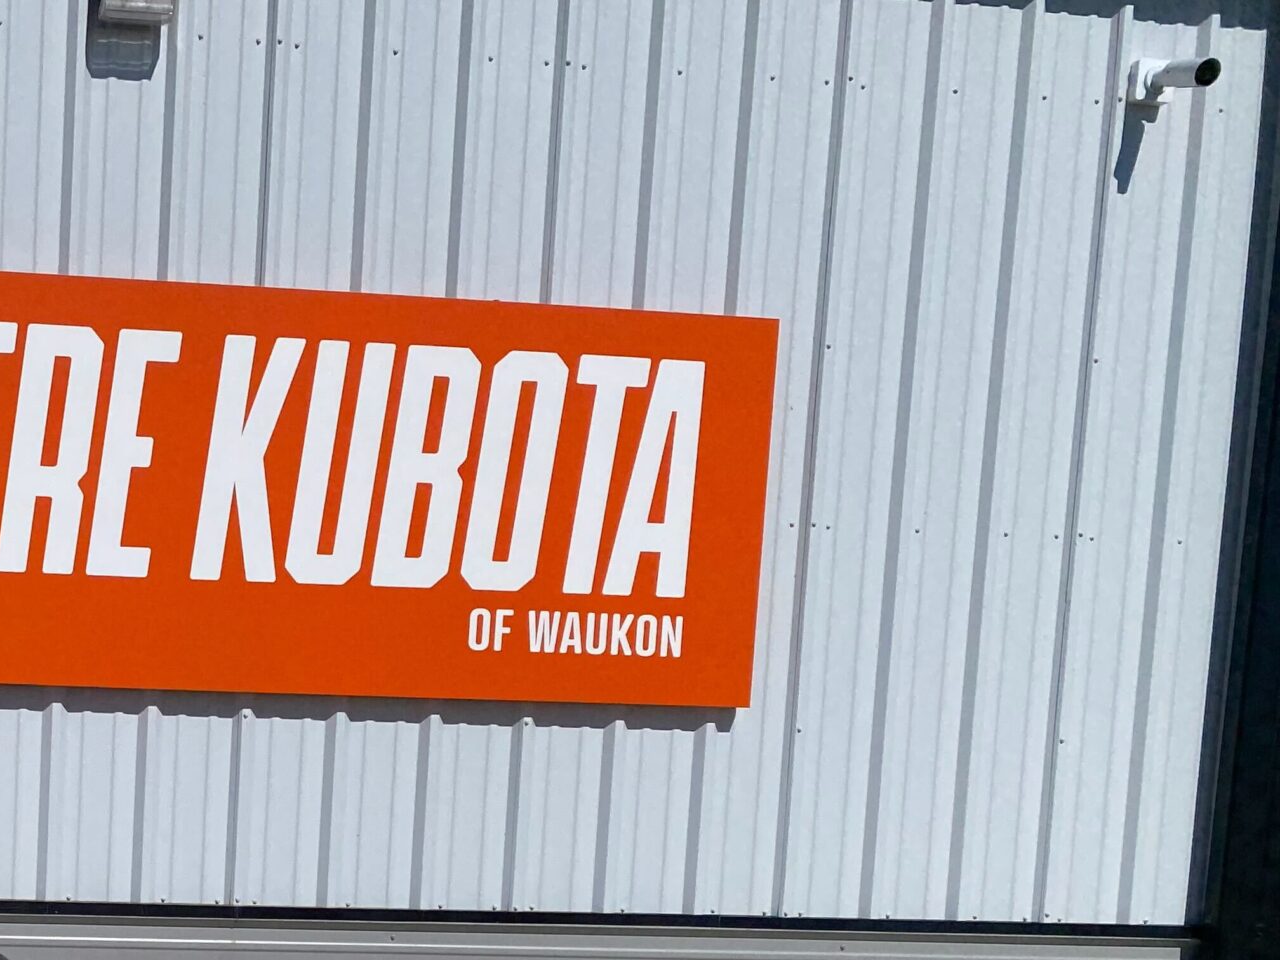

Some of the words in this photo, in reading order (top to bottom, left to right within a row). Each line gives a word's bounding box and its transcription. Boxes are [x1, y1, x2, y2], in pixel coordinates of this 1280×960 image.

[190, 334, 706, 598] KUBOTA
[468, 608, 514, 652] OF
[528, 610, 683, 658] WAUKON
